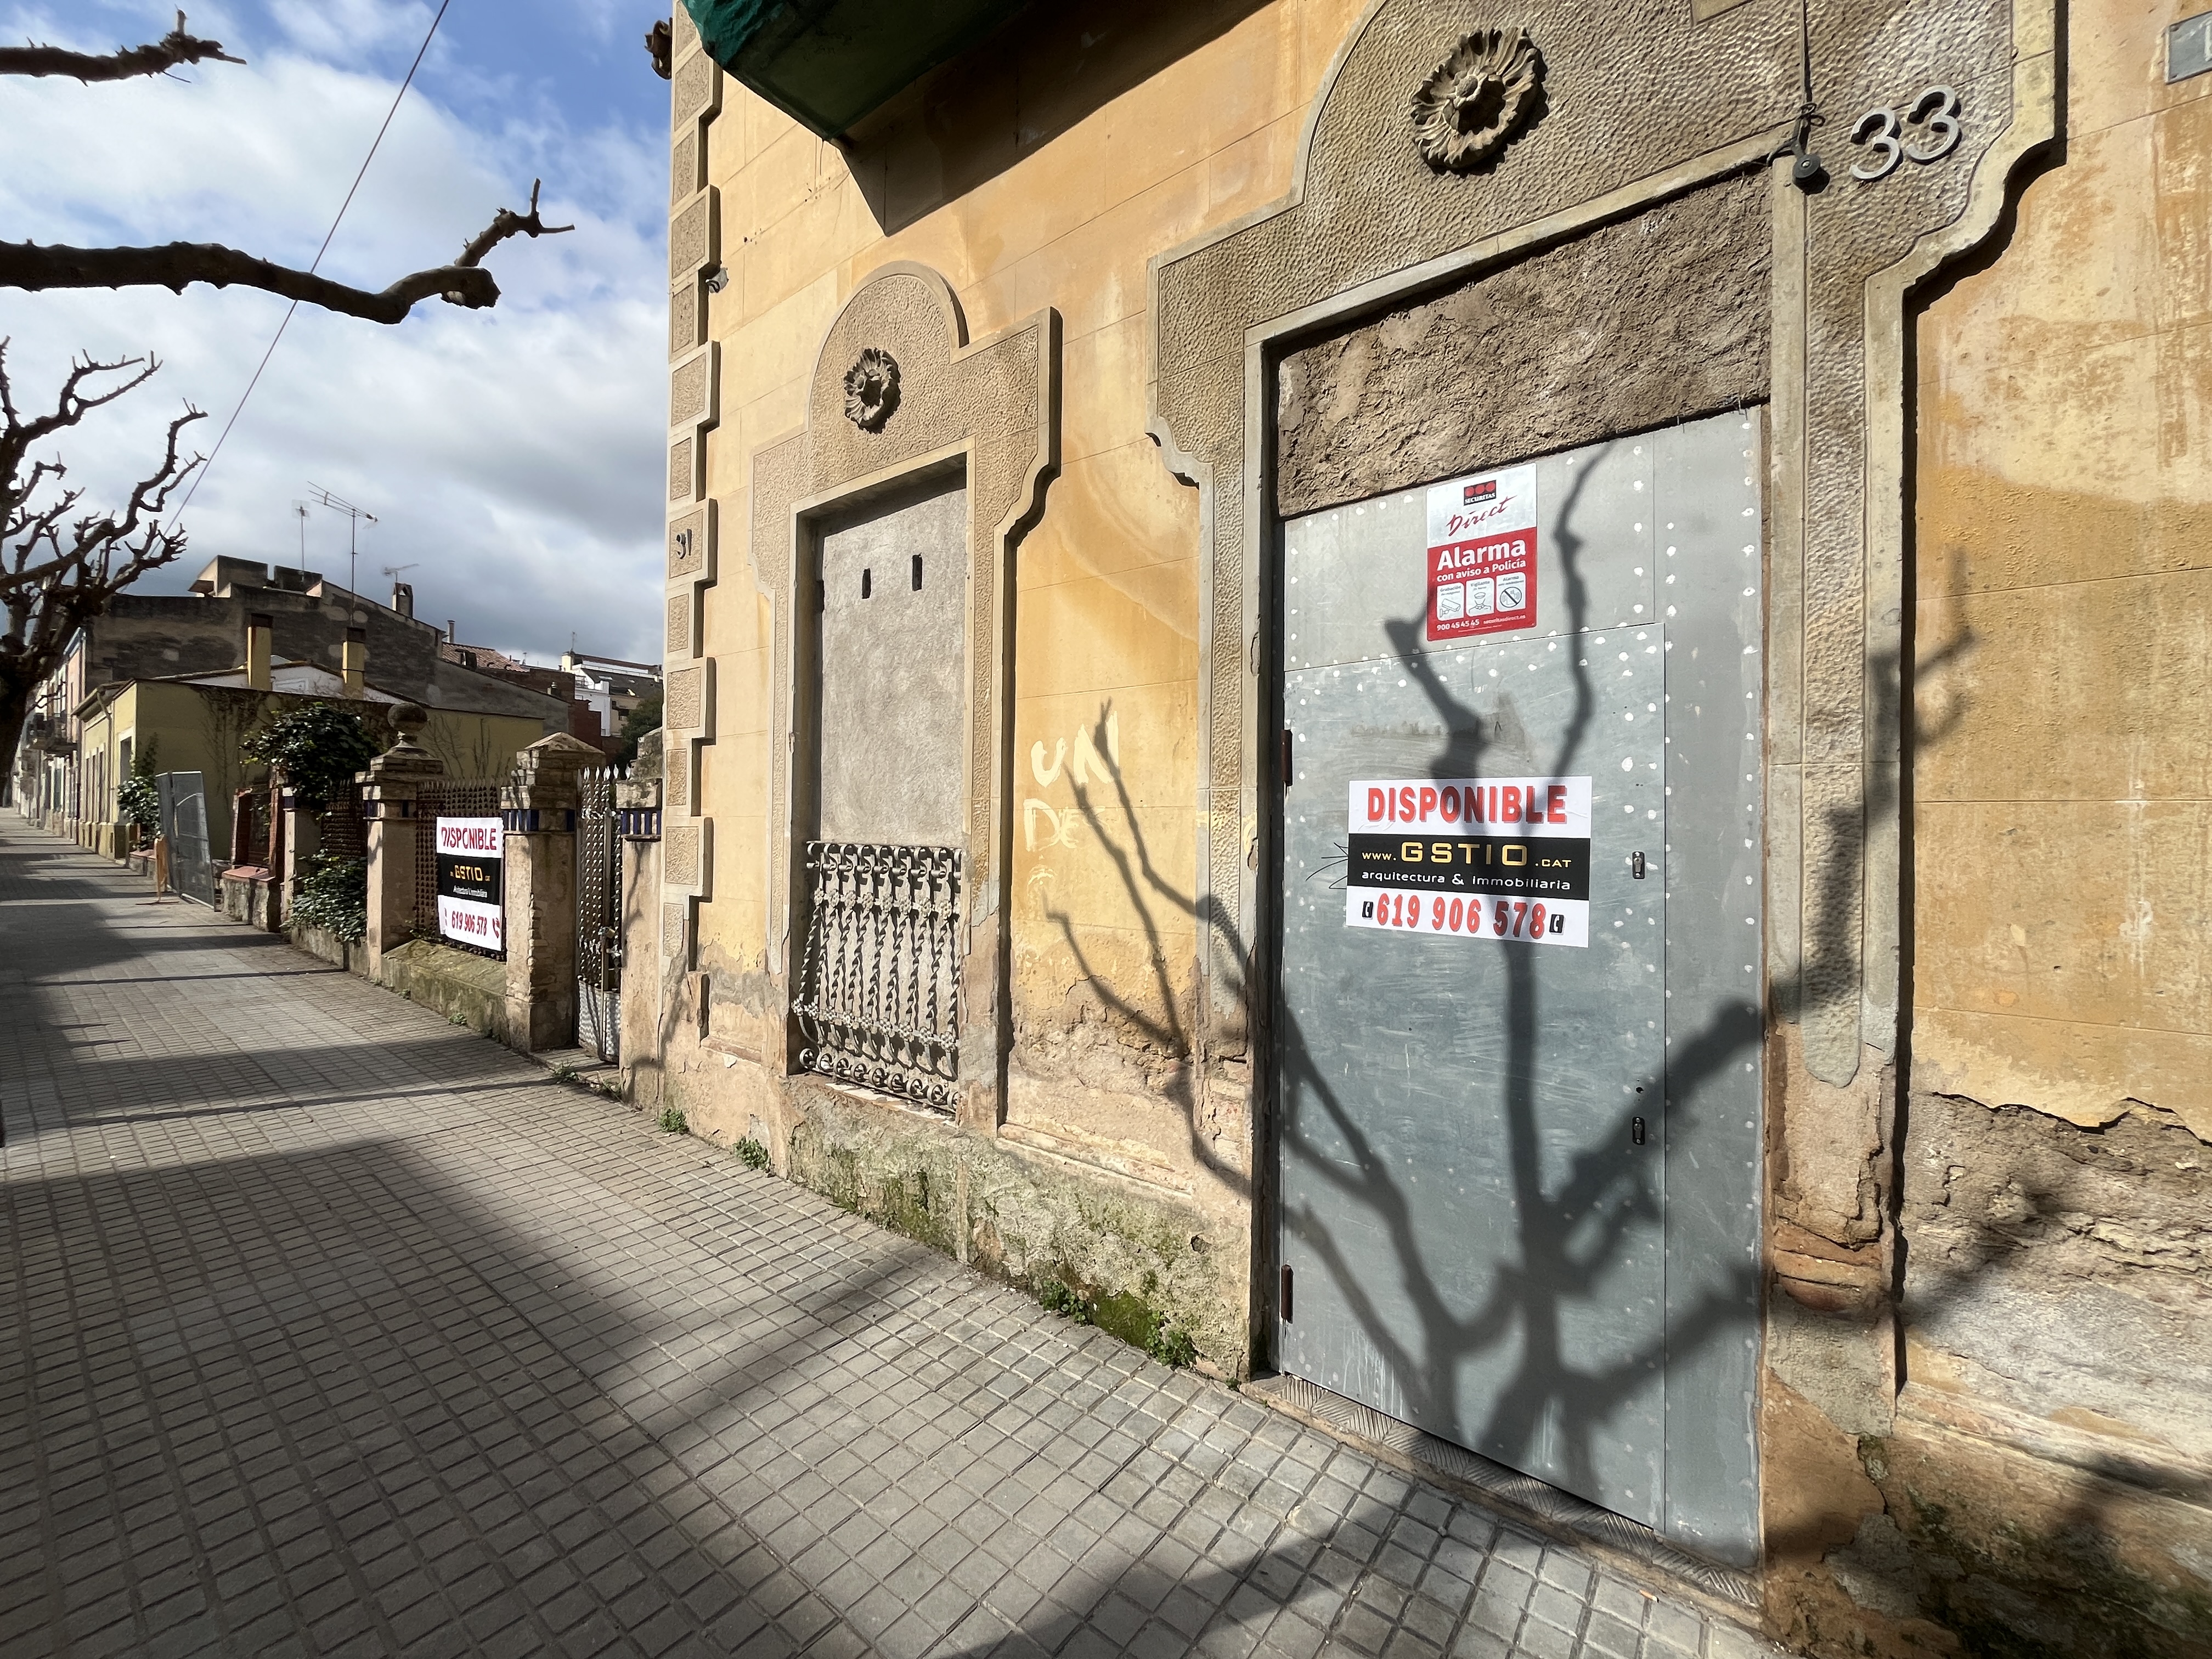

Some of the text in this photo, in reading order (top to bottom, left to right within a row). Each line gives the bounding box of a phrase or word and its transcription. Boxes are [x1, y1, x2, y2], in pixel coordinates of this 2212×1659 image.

[1850, 84, 1960, 180] 33
[1464, 493, 1496, 504] SECURITAS
[1446, 495, 1518, 537] Direct
[1437, 540, 1526, 571] Alarma
[1436, 572, 1454, 582] con
[1455, 567, 1481, 578] aviso
[1492, 558, 1526, 572] Policía
[1367, 785, 1568, 824] DISPONIBLE
[441, 827, 497, 850] DISPONIBLE
[1361, 870, 1571, 890] arquitectura & immobiliaria
[452, 911, 487, 936] 619 906 578
[1376, 893, 1547, 940] 619 906 578
